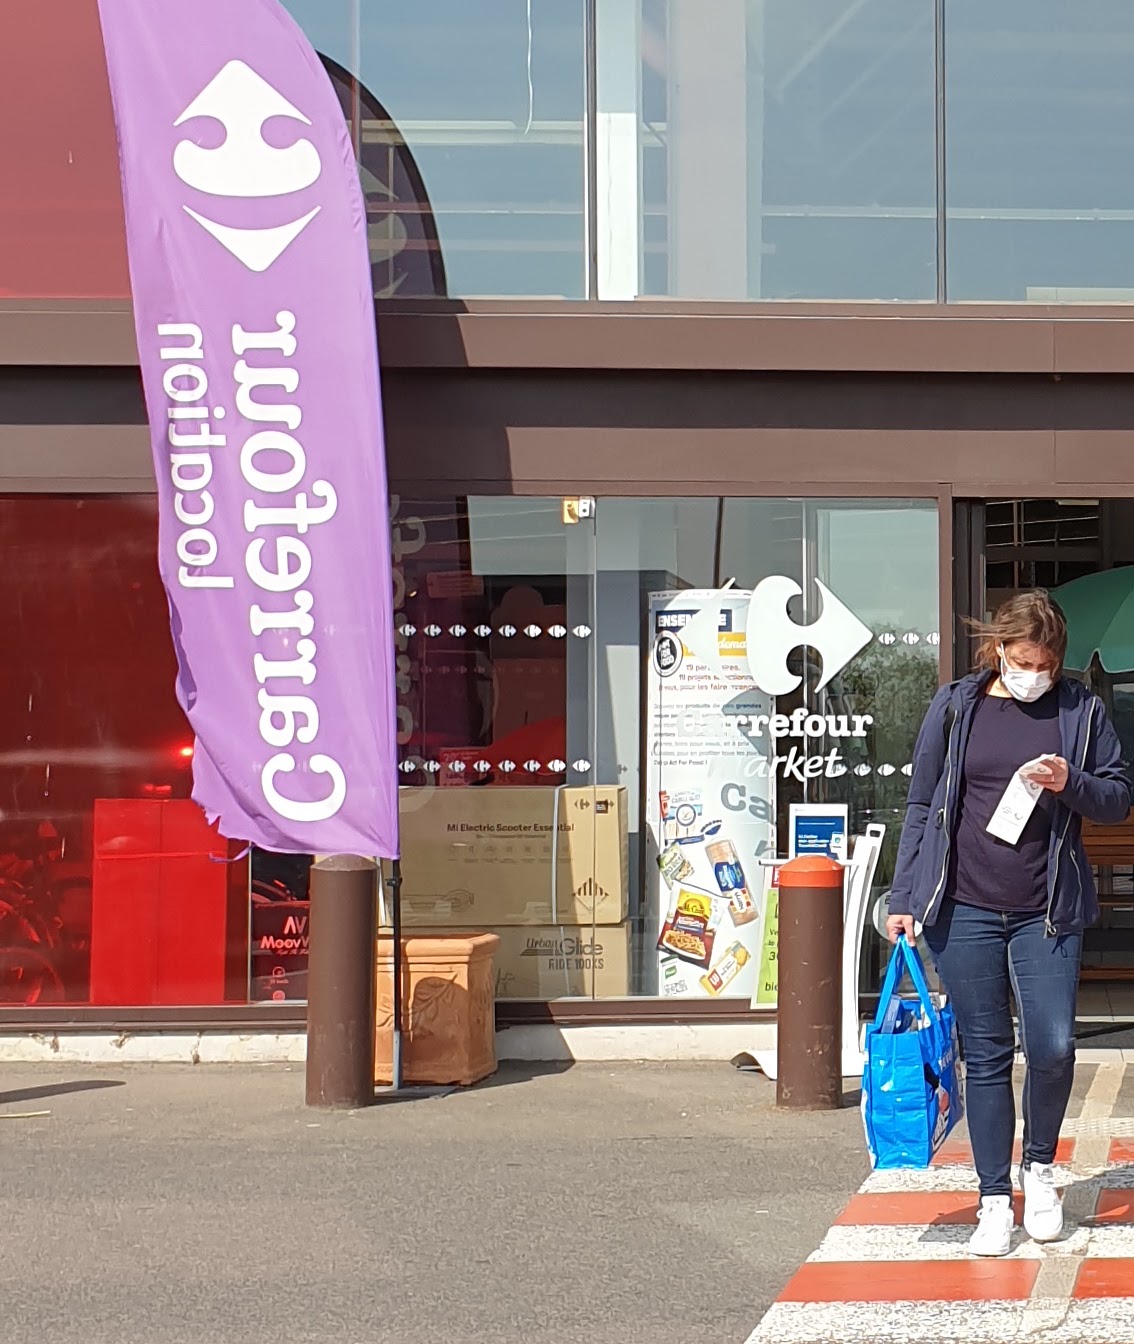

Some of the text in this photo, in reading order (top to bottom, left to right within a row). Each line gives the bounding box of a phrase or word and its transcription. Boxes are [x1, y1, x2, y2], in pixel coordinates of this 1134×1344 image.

[460, 823, 495, 832] Electric
[496, 823, 532, 832] Scooter
[533, 823, 575, 832] Essetial
[559, 937, 604, 956] Glide
